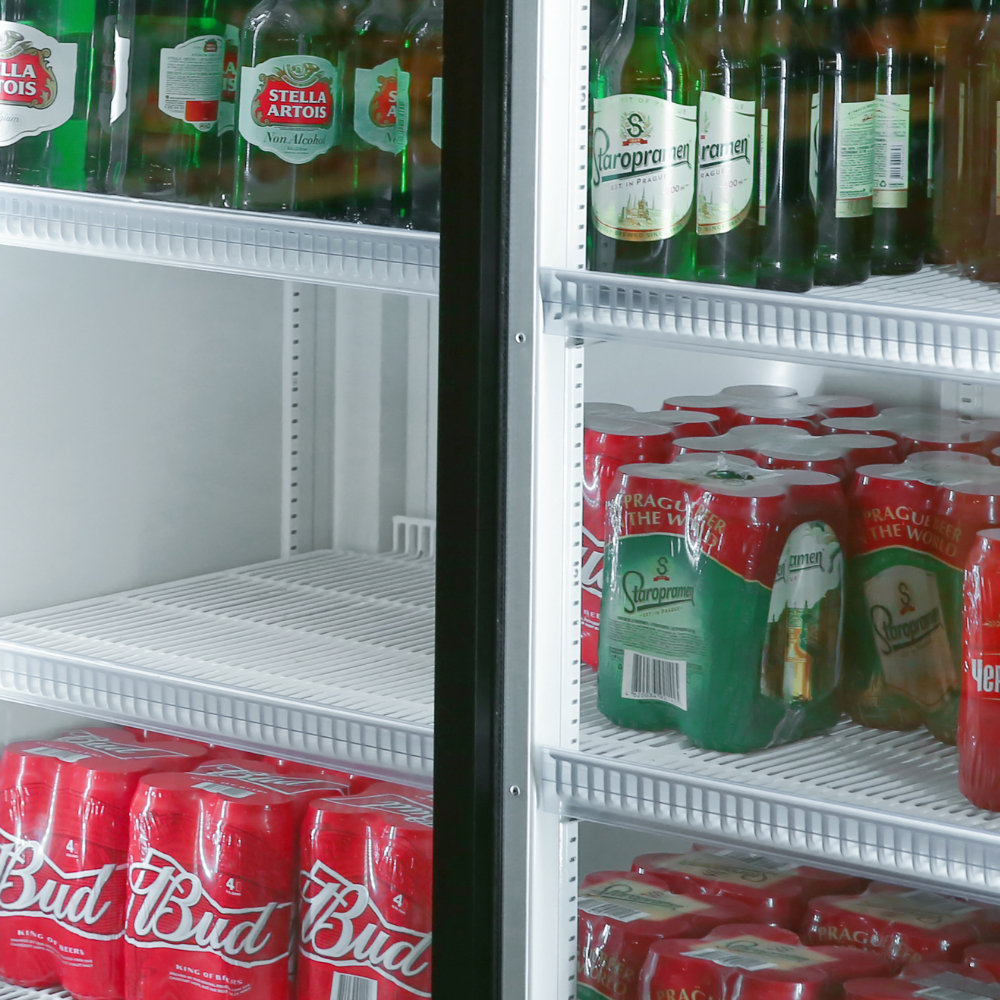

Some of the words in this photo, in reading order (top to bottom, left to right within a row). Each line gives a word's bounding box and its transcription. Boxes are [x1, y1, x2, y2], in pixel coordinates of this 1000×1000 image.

[269, 89, 327, 104] STELLA
[267, 105, 327, 119] ARTOIS
[262, 131, 287, 144] Non
[288, 131, 327, 145] Alcohol
[624, 494, 688, 512] PRAGU
[627, 511, 662, 526] THE
[864, 505, 932, 527] PRAGUE
[934, 516, 963, 542] BEER
[870, 525, 902, 541] THE
[907, 525, 958, 558] WORLD
[622, 570, 696, 614] Staropramen
[971, 658, 1000, 693] Чер
[66, 839, 75, 853] 4
[226, 877, 235, 891] 4
[129, 862, 279, 956] Bud
[393, 893, 403, 908] 4
[300, 870, 433, 977] Bud
[17, 929, 44, 940] KING
[47, 936, 58, 946] OF
[59, 944, 85, 956] BEERS
[176, 964, 200, 976] KING
[203, 971, 214, 980] OF
